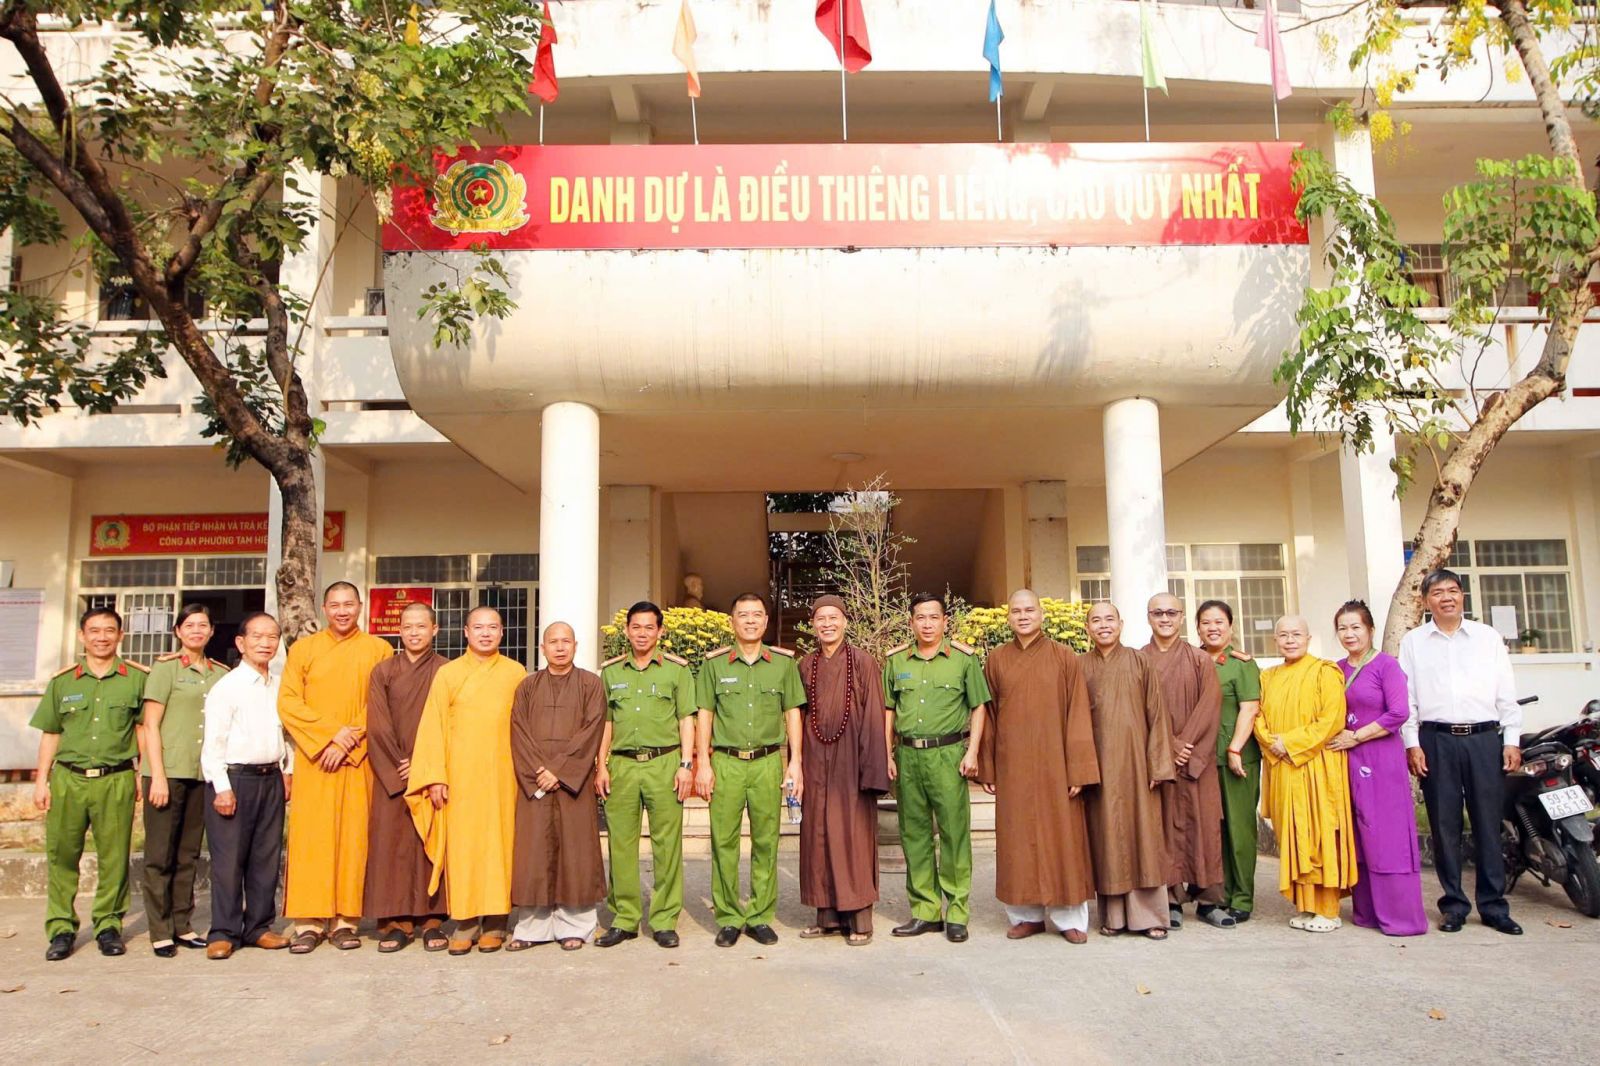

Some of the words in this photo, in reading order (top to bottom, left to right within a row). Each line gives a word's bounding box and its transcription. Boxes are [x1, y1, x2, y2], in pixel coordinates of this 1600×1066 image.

[550, 177, 635, 223] DANH
[644, 171, 688, 233] DỰ
[694, 166, 731, 222] LÀ
[739, 160, 810, 222] ĐIỀU
[818, 165, 930, 221] THIÊNG
[1046, 175, 1105, 220] CAO
[1181, 156, 1260, 219] NHẤT
[143, 522, 155, 532] BỘ
[157, 521, 180, 533] PHẬN
[183, 520, 200, 531] TIẾP
[202, 520, 225, 532] NHẬN
[227, 519, 238, 530] VÀ
[257, 519, 268, 530] KẾ
[159, 536, 183, 546] CÔNG
[185, 537, 196, 545] AN
[236, 535, 253, 545] TAM
